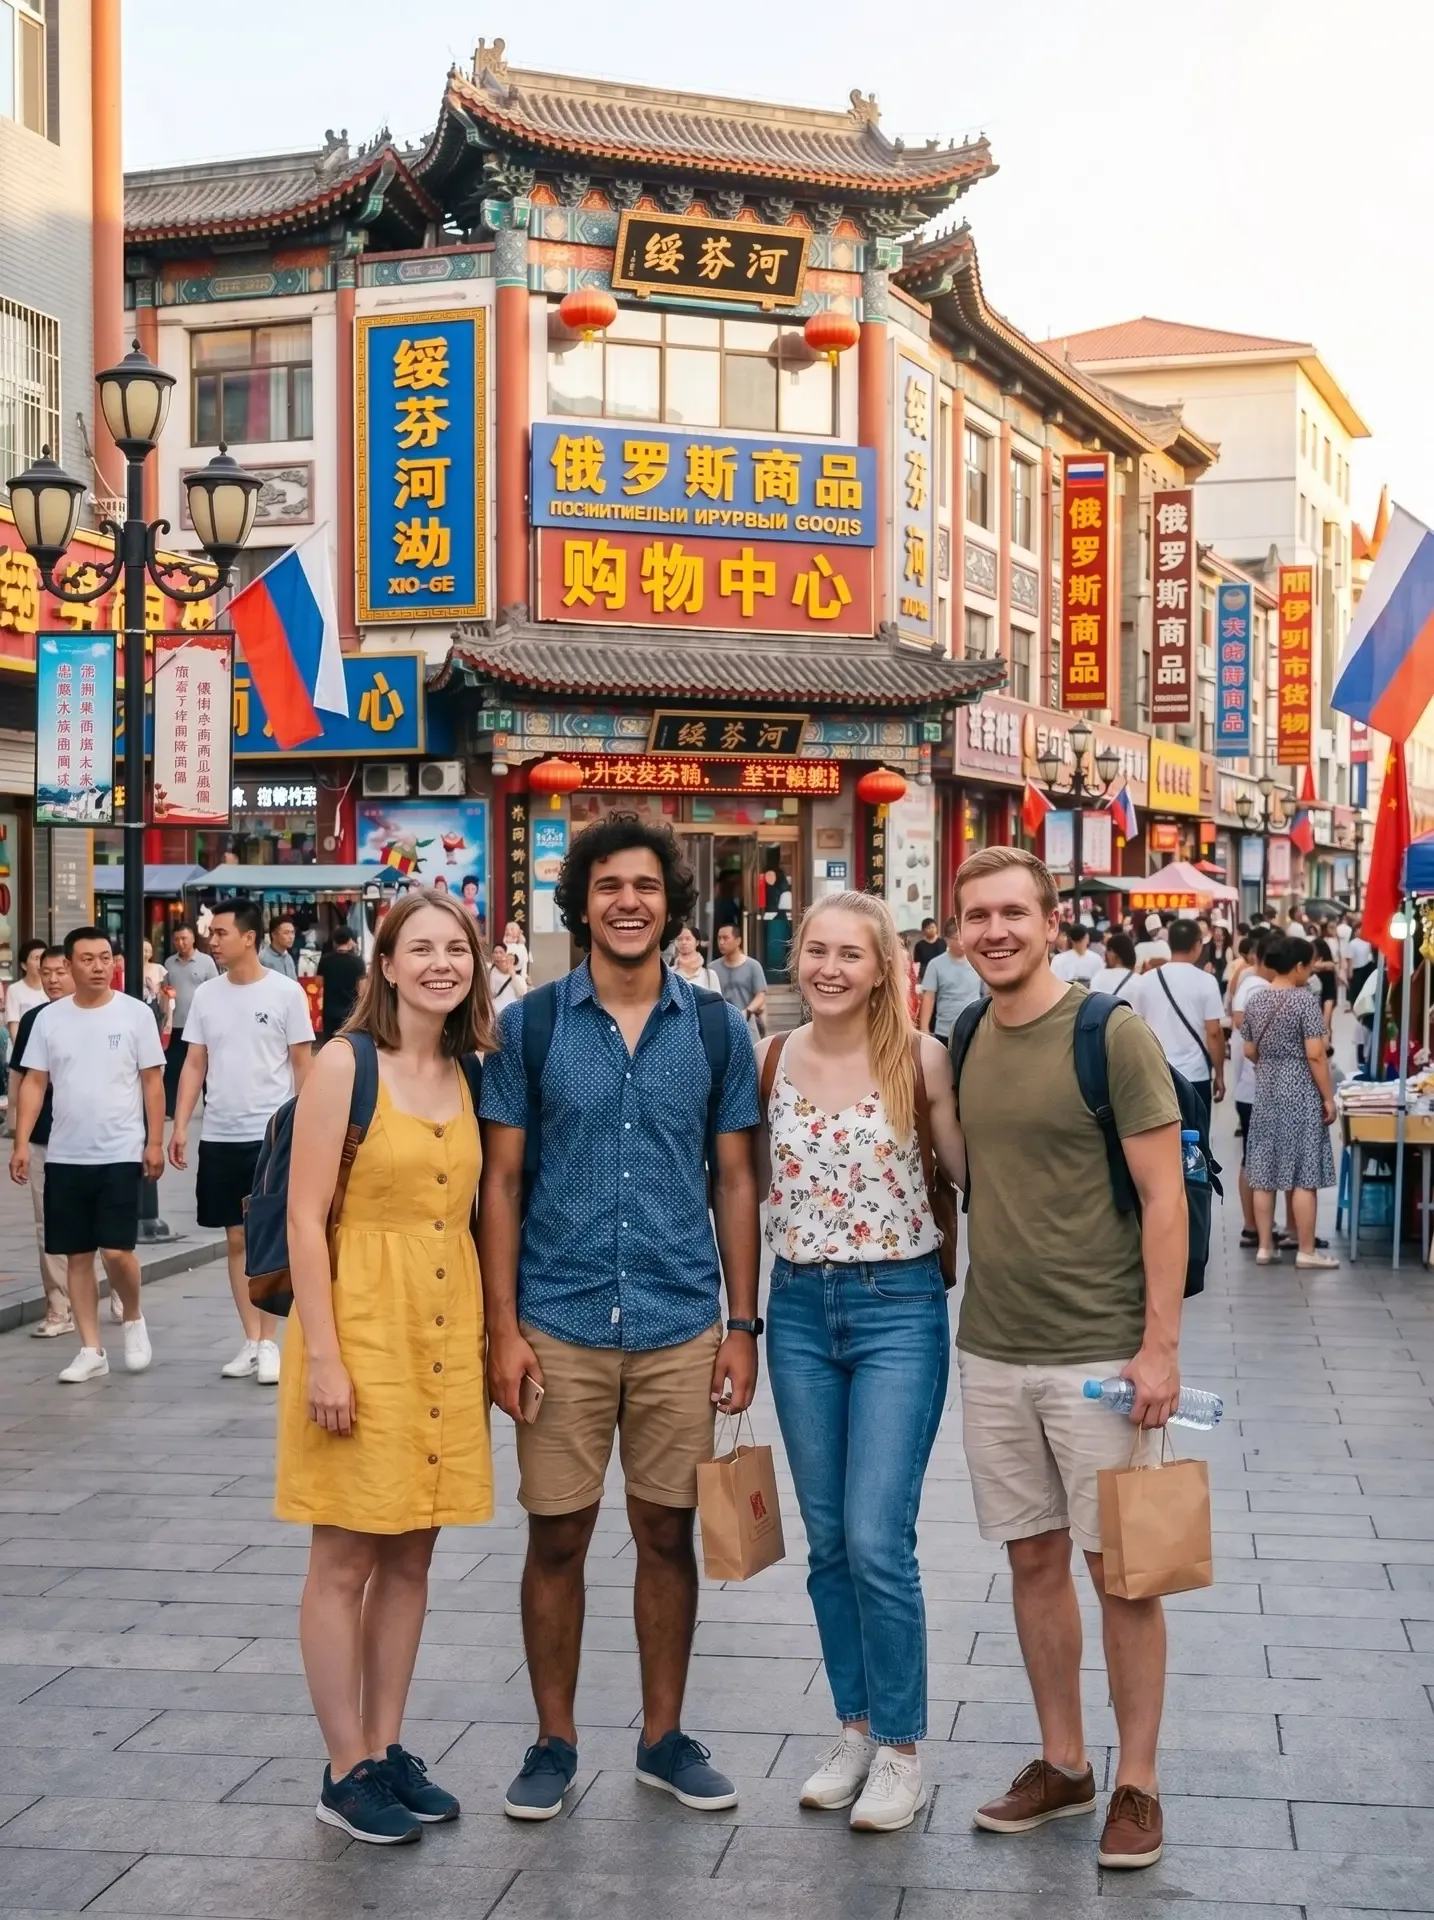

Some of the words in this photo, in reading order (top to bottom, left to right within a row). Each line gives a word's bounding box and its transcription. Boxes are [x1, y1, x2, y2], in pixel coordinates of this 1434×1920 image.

[643, 232, 789, 285] 绥芬河
[550, 434, 862, 510] 俄罗斯商品
[562, 538, 852, 620] 购物中心
[1068, 497, 1102, 684] 俄罗斯商品
[1156, 503, 1188, 685] 俄罗斯商品
[677, 722, 789, 750] 绥芬河
